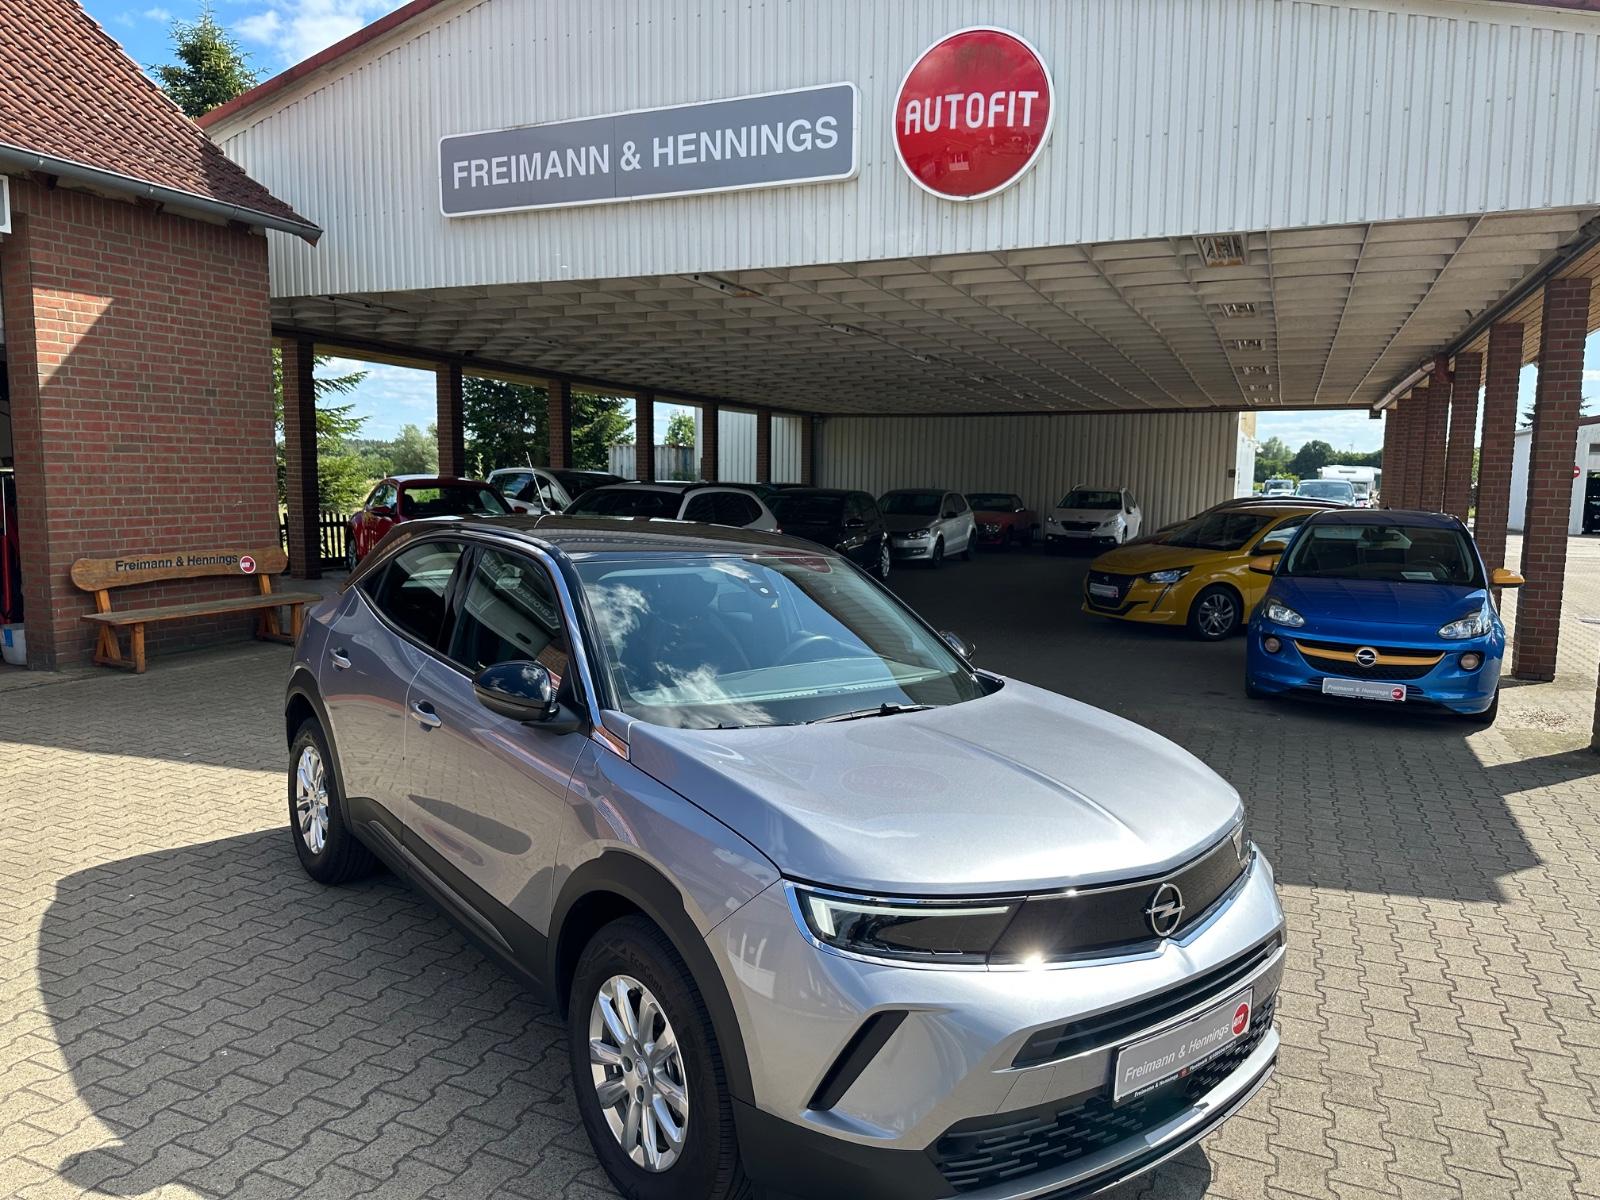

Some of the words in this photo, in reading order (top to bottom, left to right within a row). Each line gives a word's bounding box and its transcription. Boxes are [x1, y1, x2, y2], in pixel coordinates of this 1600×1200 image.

[904, 90, 1039, 136] AUTOFIT
[452, 144, 611, 190] FREIMANN
[620, 141, 642, 172] &
[652, 115, 839, 169] HENNINGS
[115, 557, 173, 572] Freimann
[176, 557, 184, 567] &
[187, 553, 238, 568] Hennings
[1124, 1052, 1176, 1083] Freimann
[1178, 1045, 1186, 1059] &
[1188, 1023, 1230, 1054] Hennings
